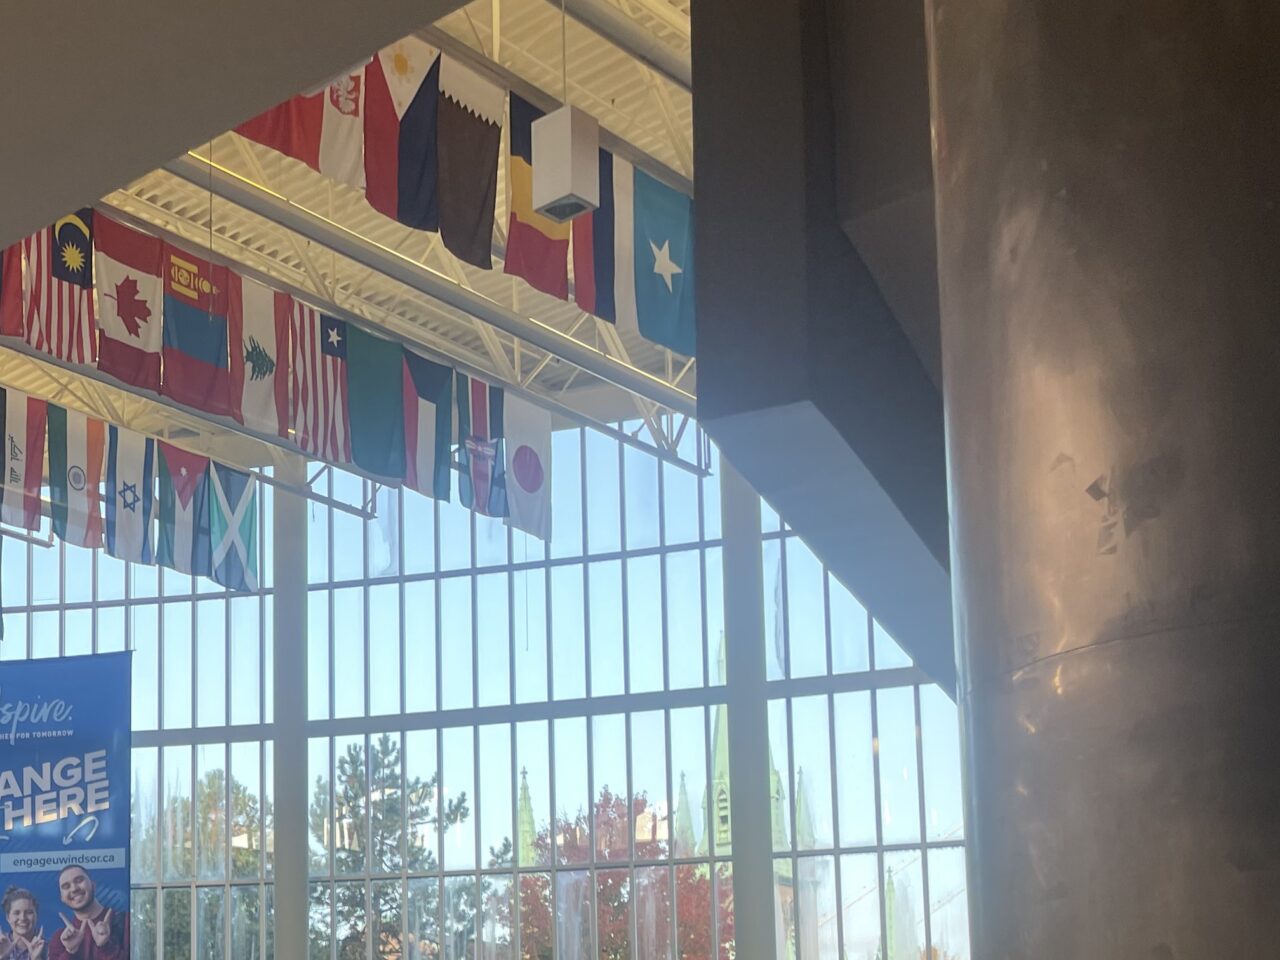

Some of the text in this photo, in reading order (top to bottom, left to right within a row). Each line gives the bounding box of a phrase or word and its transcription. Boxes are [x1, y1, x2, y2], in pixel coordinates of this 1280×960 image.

[16, 732, 30, 740] FOR
[32, 729, 74, 739] TOMORROW
[4, 780, 110, 831] HERE
[13, 853, 115, 869] engageuwindsor.ca
